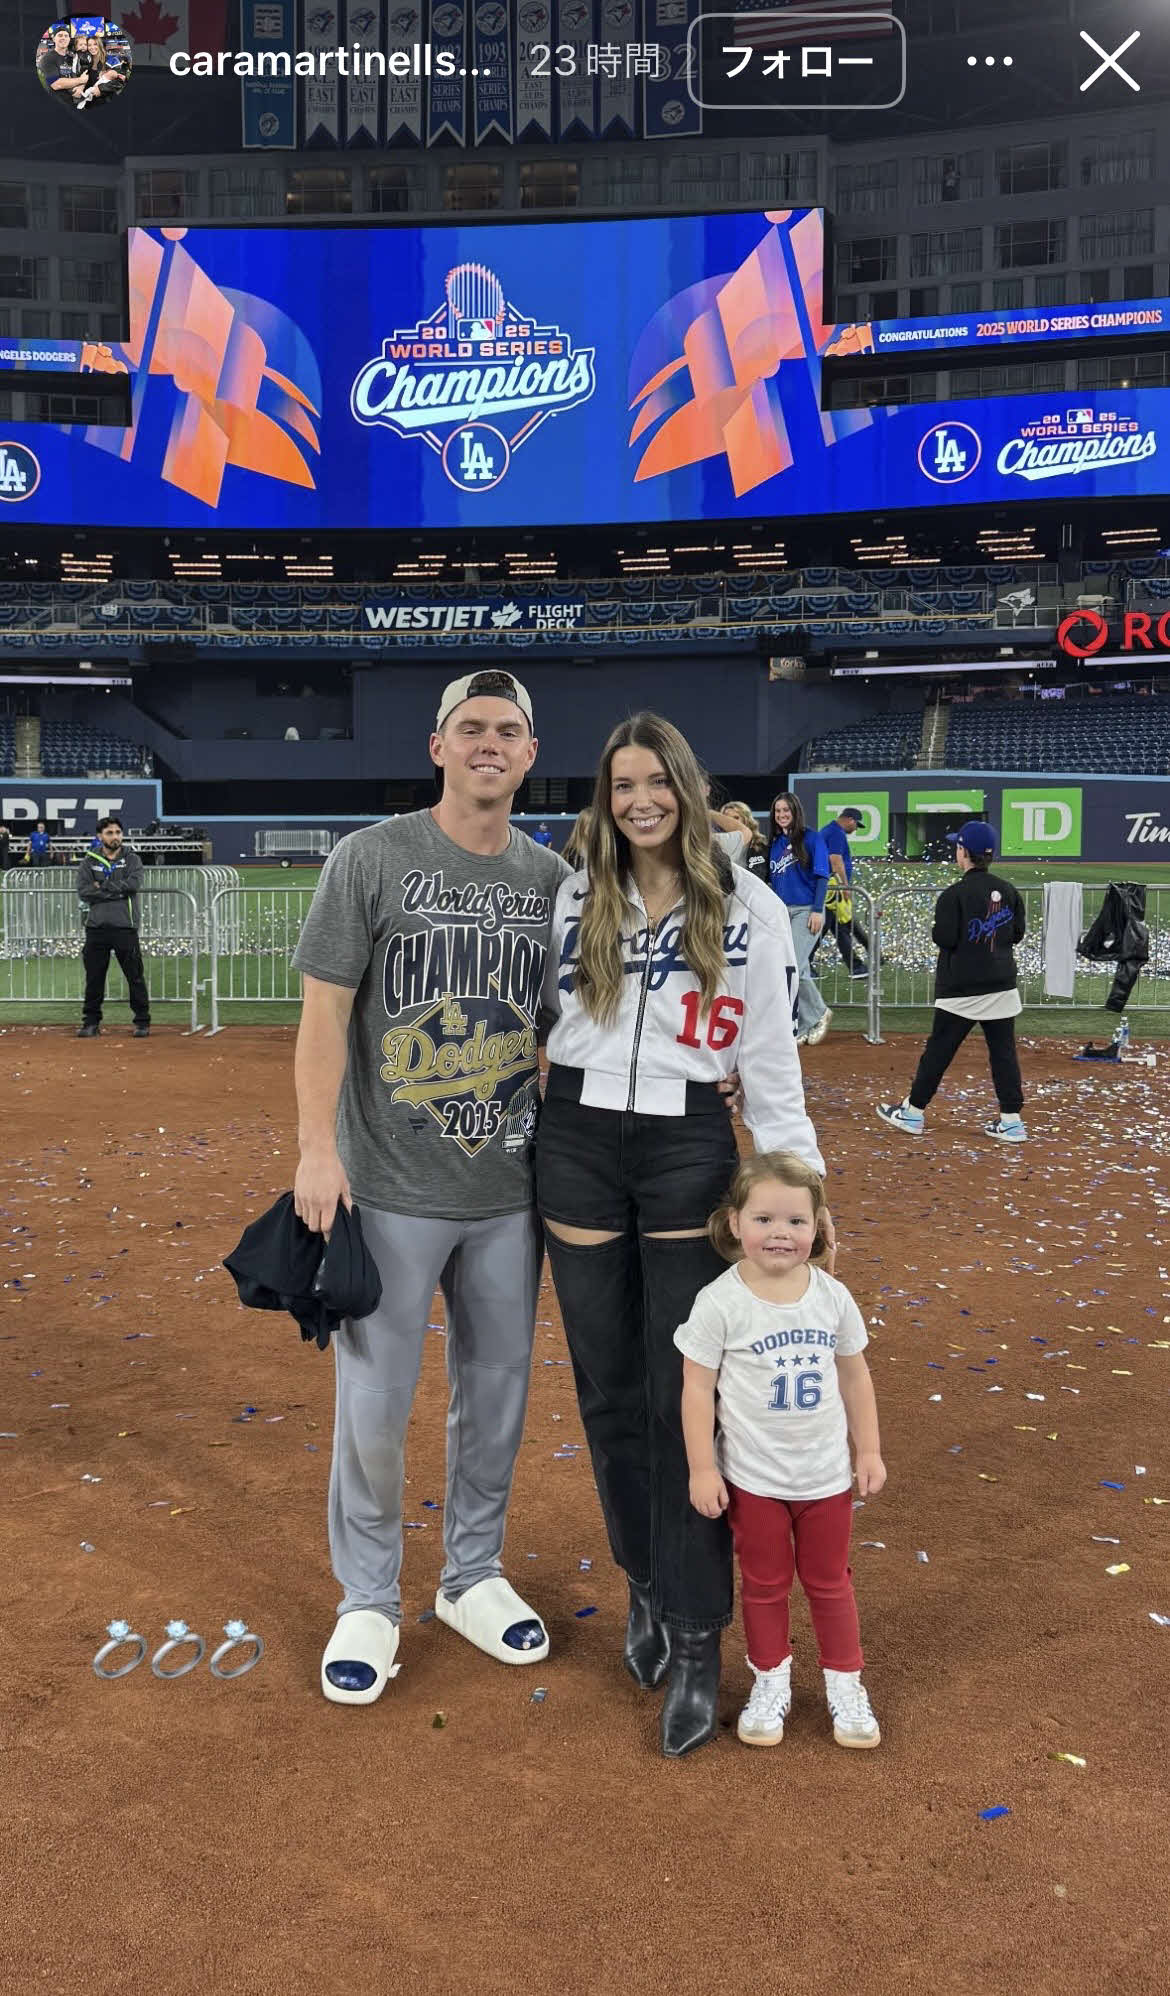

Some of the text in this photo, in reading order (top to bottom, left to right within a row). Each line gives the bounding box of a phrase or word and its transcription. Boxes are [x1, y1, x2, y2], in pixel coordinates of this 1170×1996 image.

[421, 324, 531, 339] 20 25
[879, 310, 1163, 343] CONGRATULATIONS 2025 WORLD SERIES CHAMPIONS
[32, 352, 76, 362] DODGERS
[389, 340, 564, 359] WORLD SERIES
[356, 354, 590, 422] Champions
[1021, 421, 1139, 437] WORLD SERIES
[460, 432, 494, 480] LA
[935, 430, 966, 473] LA
[997, 432, 1157, 475] Champions
[365, 604, 584, 631] WESTJET FLIGHT
[536, 618, 577, 630] DECK
[1010, 801, 1073, 842] TD
[400, 869, 492, 914] World
[440, 992, 469, 1036] LA
[676, 990, 744, 1051] 16
[440, 1101, 502, 1139] 2025
[751, 1328, 838, 1355] DODGERS
[768, 1370, 824, 1411] 16
